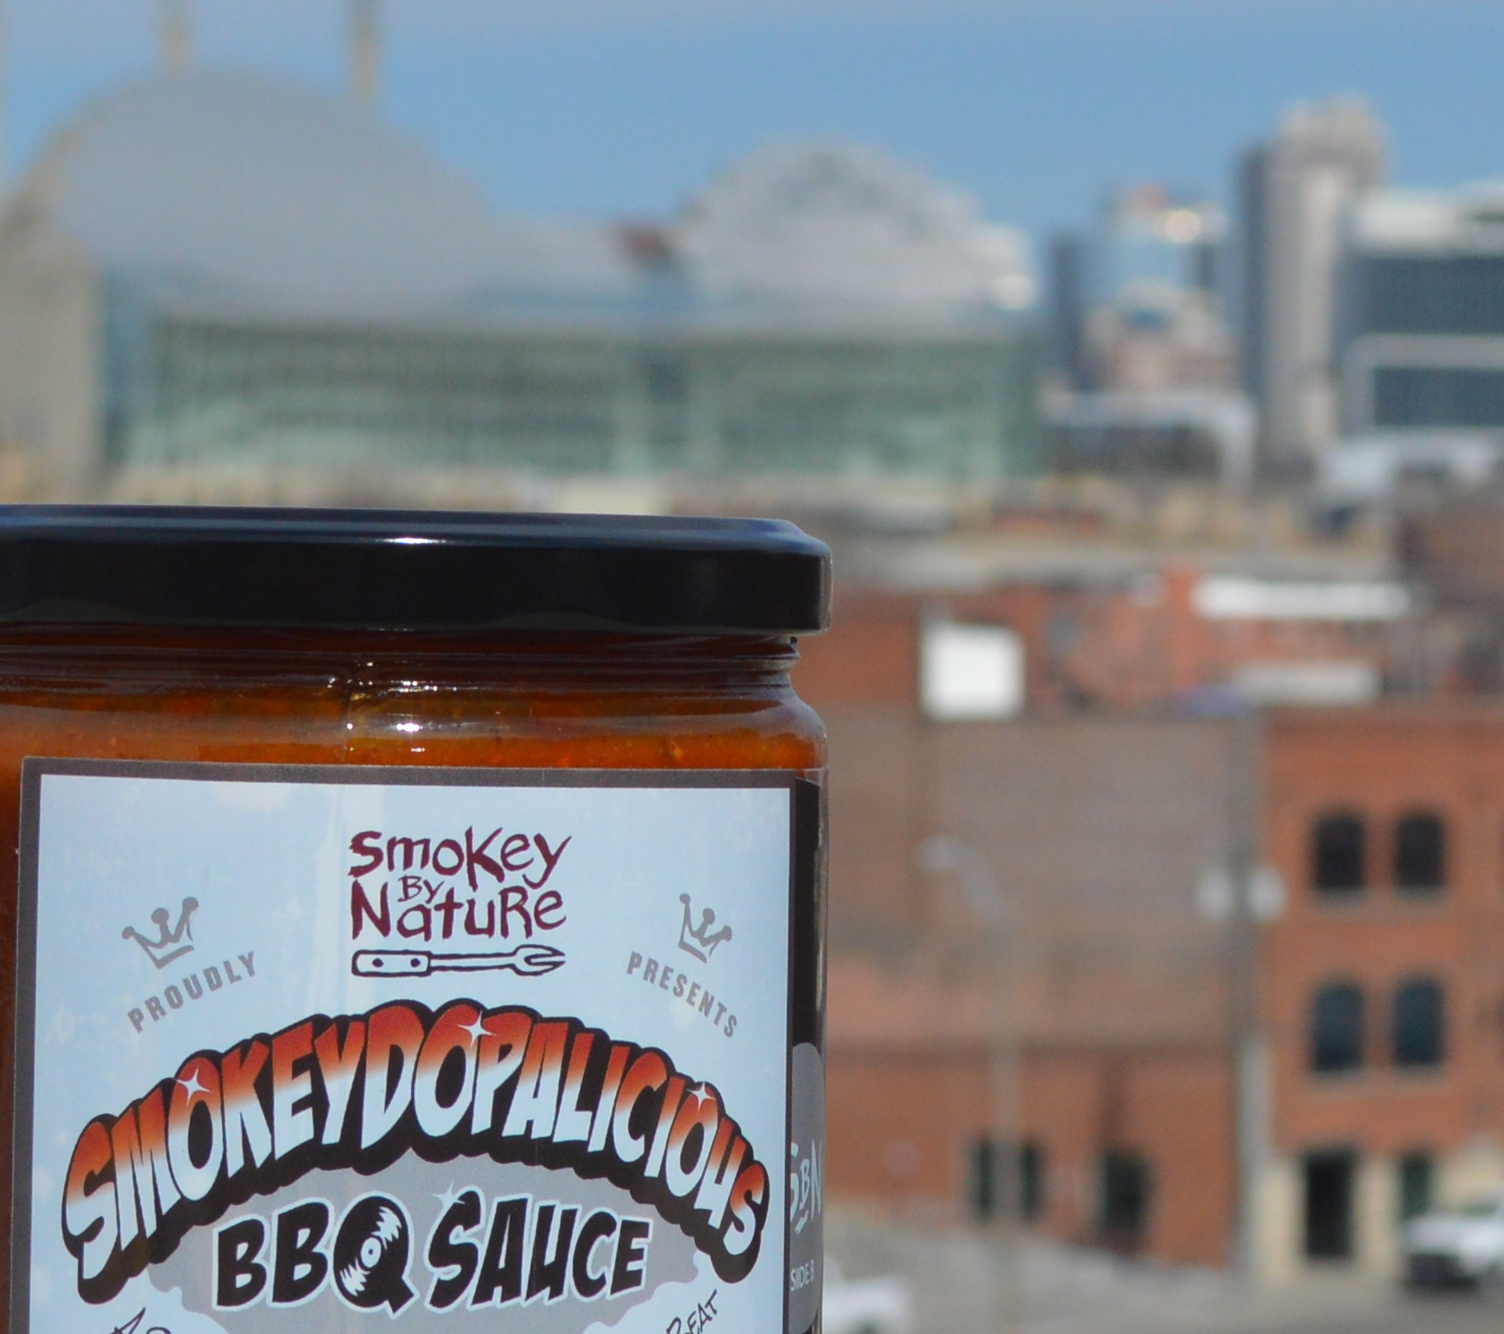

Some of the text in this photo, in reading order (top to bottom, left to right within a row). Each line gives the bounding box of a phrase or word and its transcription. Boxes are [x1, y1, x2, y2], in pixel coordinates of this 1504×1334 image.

[397, 875, 445, 904] By
[126, 950, 256, 1034] PROUDLY
[626, 951, 738, 1038] PRESENTS
[63, 1001, 768, 1291] SMOKEYDOPALICIOUS
[215, 1187, 653, 1316] BBQ SAUCE
